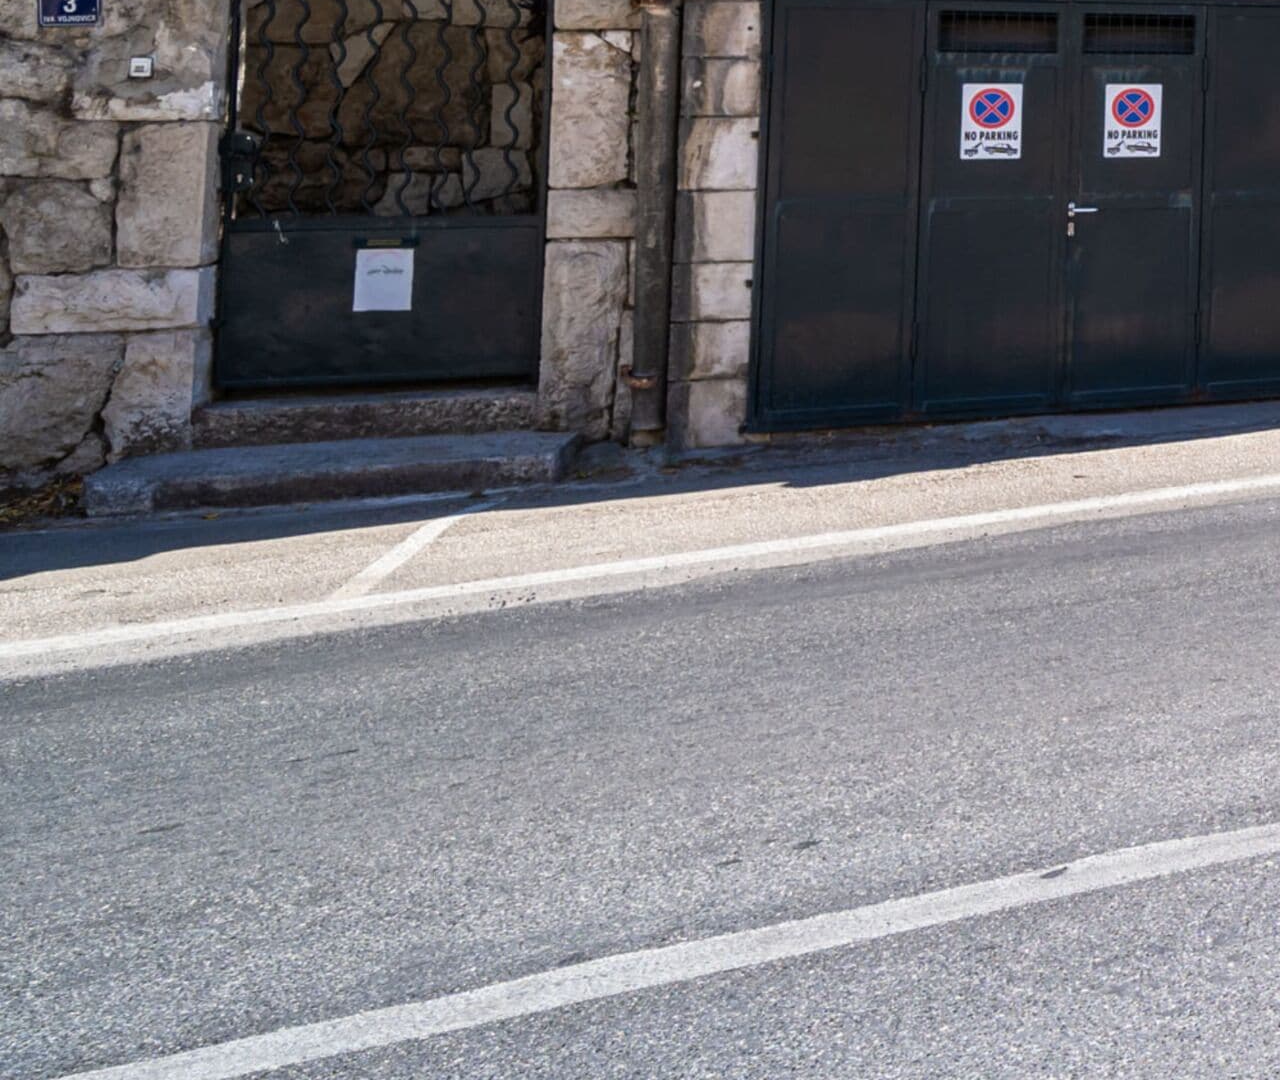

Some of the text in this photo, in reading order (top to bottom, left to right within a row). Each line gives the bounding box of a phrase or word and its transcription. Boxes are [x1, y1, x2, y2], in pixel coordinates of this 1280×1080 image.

[964, 131, 1019, 141] NO PARKING
[1107, 129, 1158, 139] NO PARKING
